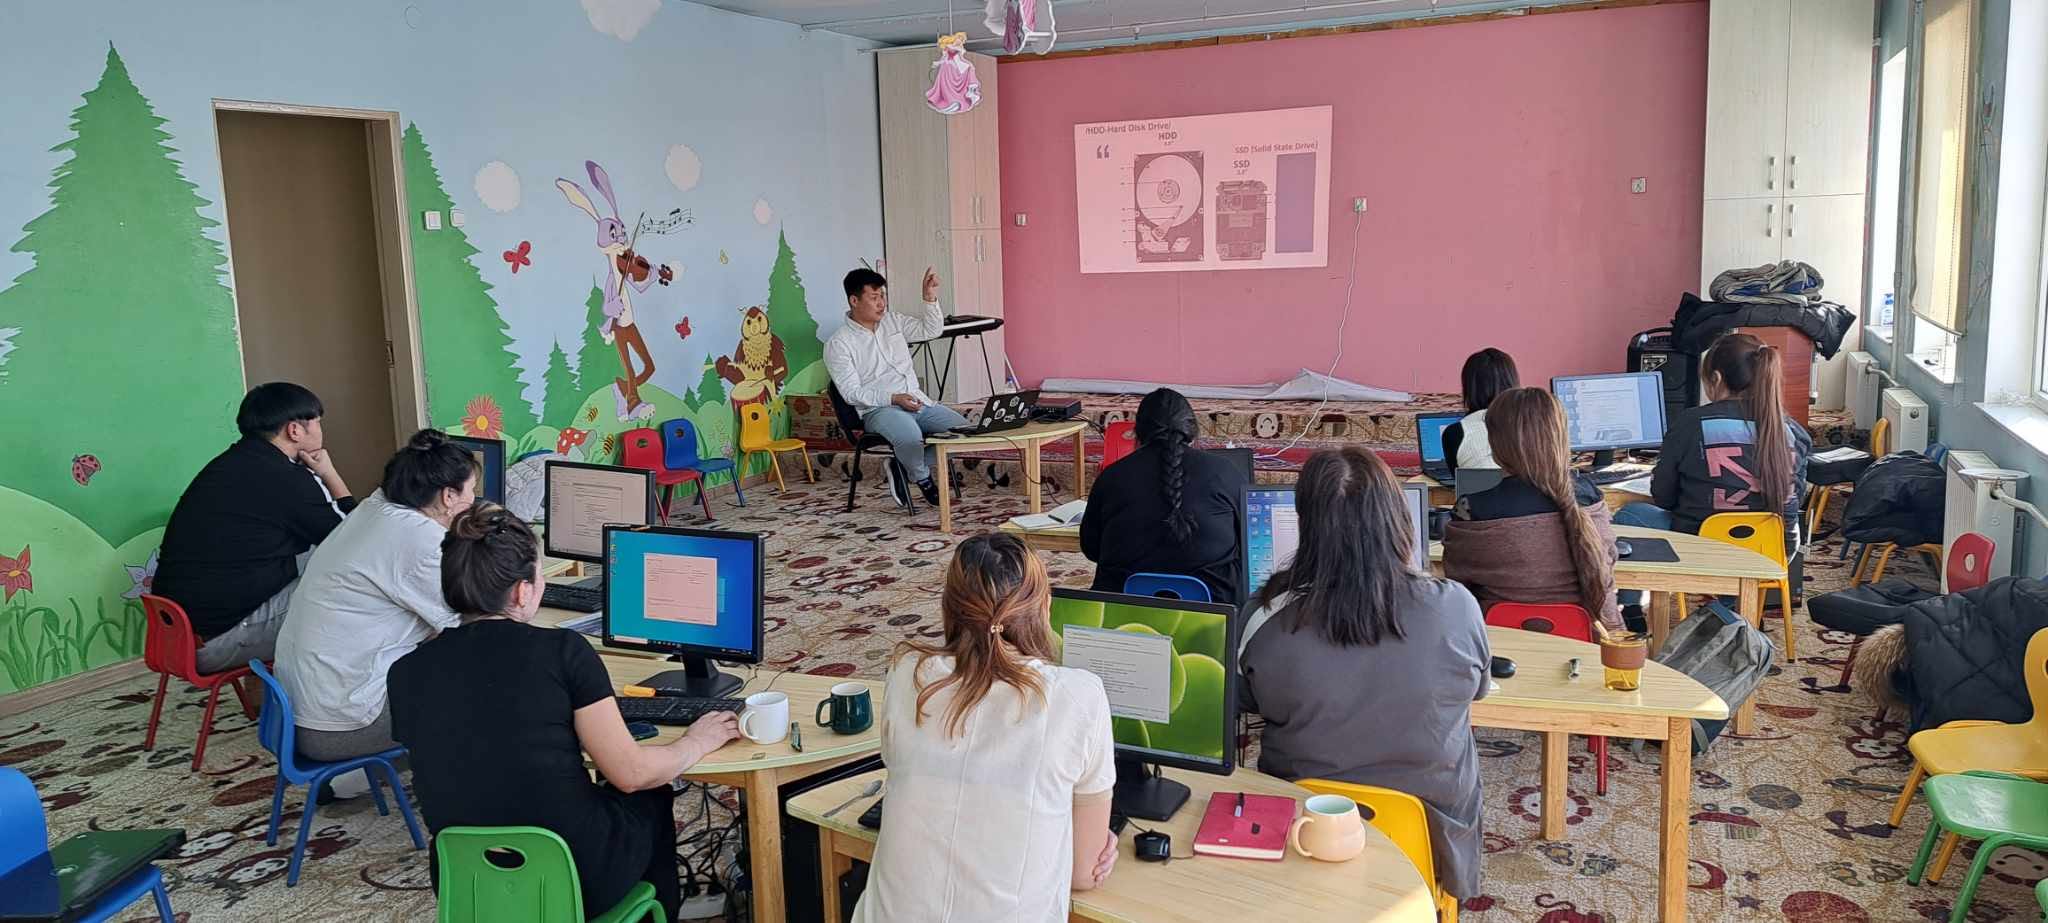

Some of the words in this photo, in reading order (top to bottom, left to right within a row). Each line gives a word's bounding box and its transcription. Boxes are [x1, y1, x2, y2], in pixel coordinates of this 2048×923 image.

[1128, 123, 1147, 132] Disk
[1158, 131, 1178, 140] HDD
[1234, 145, 1250, 154] SSD
[1273, 143, 1293, 152] State
[1232, 159, 1250, 168] SSD
